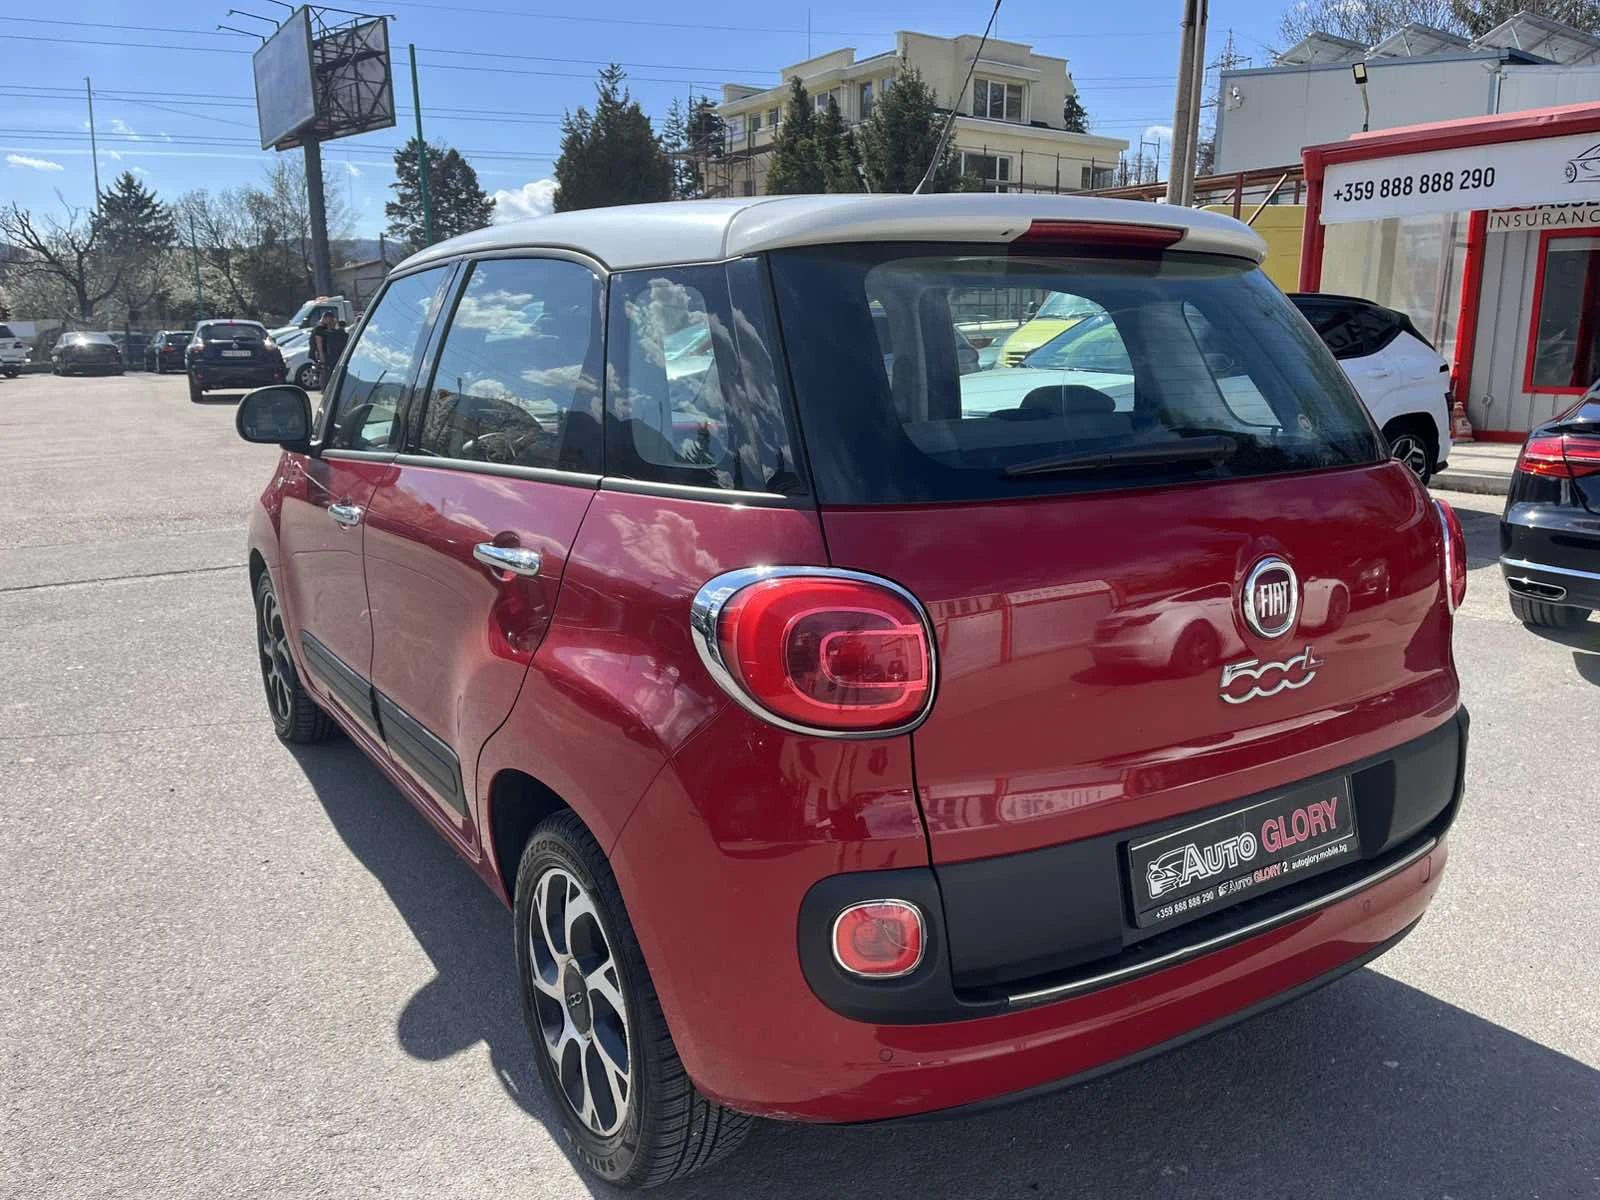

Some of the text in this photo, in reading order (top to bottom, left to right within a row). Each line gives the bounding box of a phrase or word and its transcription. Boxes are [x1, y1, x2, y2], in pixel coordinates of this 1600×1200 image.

[1333, 167, 1495, 202] +359 888 888 290
[1259, 580, 1289, 618] FIAT
[1261, 796, 1338, 853] GLORY
[1155, 906, 1173, 919] +359
[1174, 901, 1187, 913] 888
[1188, 896, 1201, 908] 888
[1202, 891, 1214, 904] 290
[1253, 862, 1281, 883] GLORY
[1282, 861, 1289, 873] 2
[1291, 843, 1348, 869] autoglory.mobile.bg
